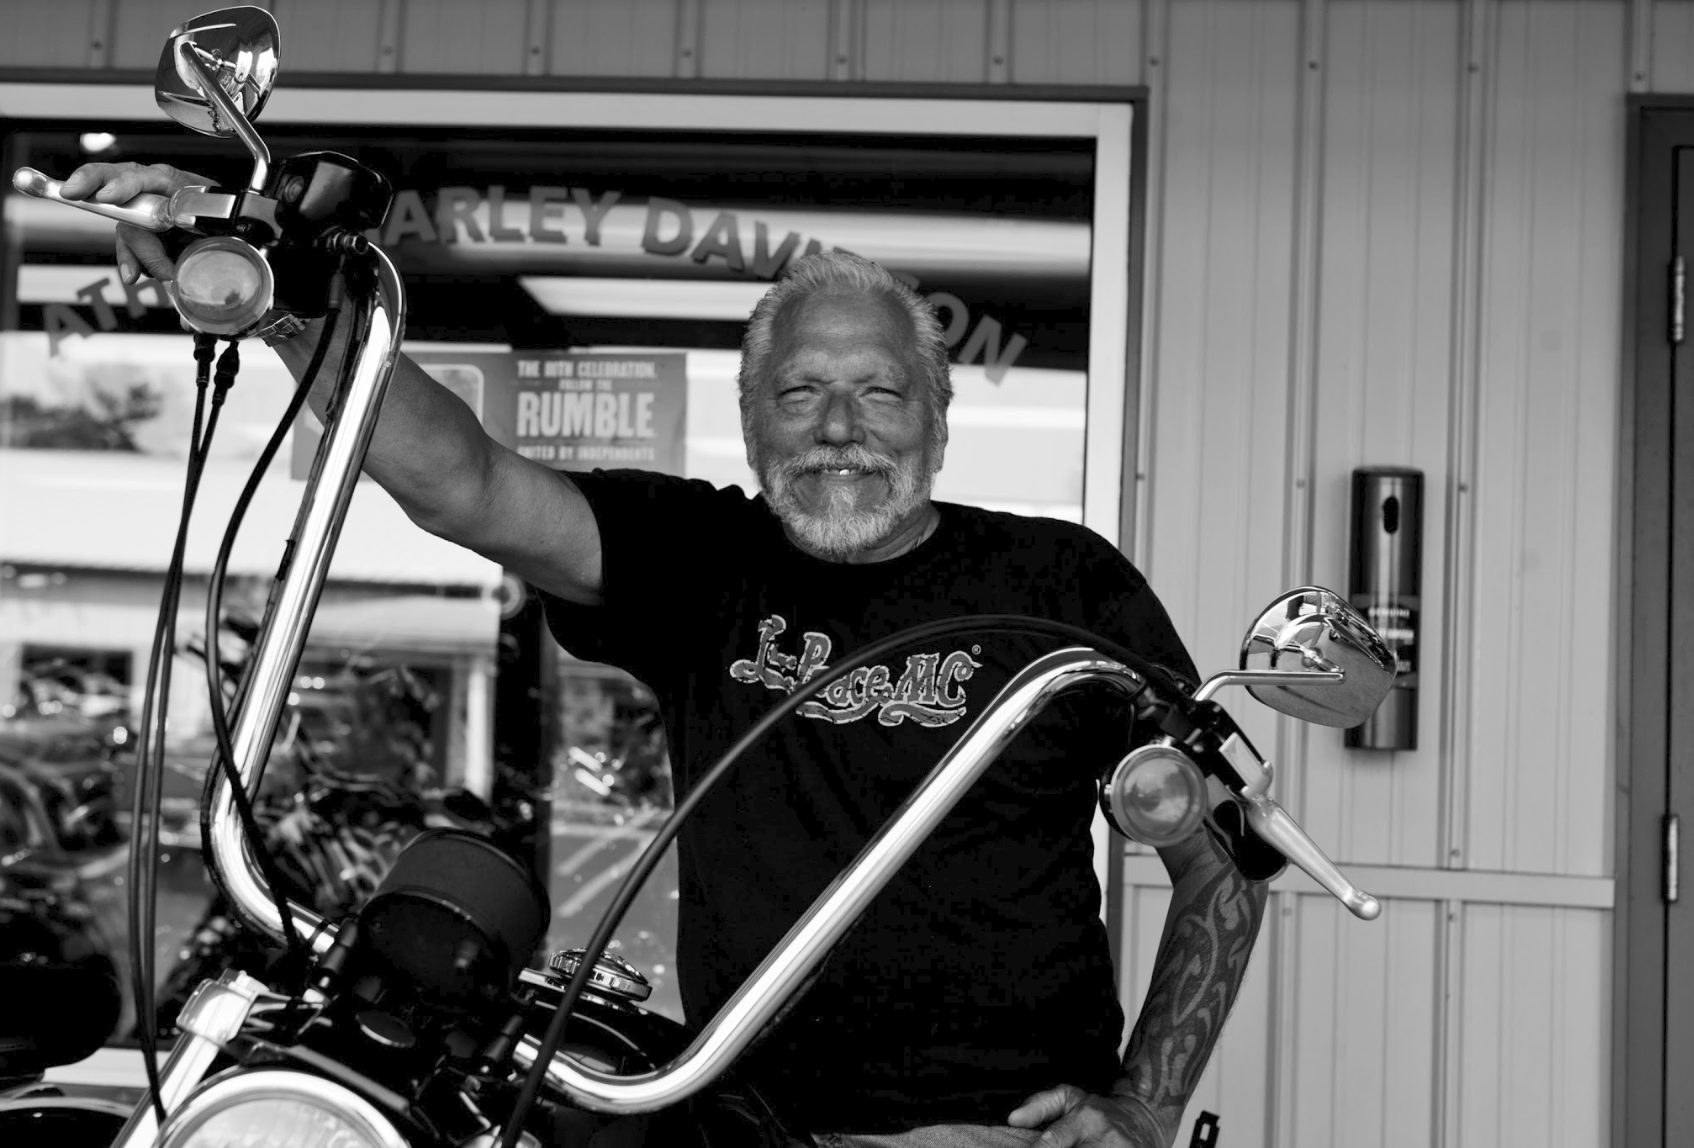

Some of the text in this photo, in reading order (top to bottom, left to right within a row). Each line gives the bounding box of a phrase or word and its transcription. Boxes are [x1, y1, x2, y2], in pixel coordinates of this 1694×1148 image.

[364, 185, 622, 248] ARLEY
[641, 196, 1028, 386] DAVON
[517, 360, 541, 378] THE
[516, 391, 656, 438] RUMBLE
[558, 446, 574, 461] BY
